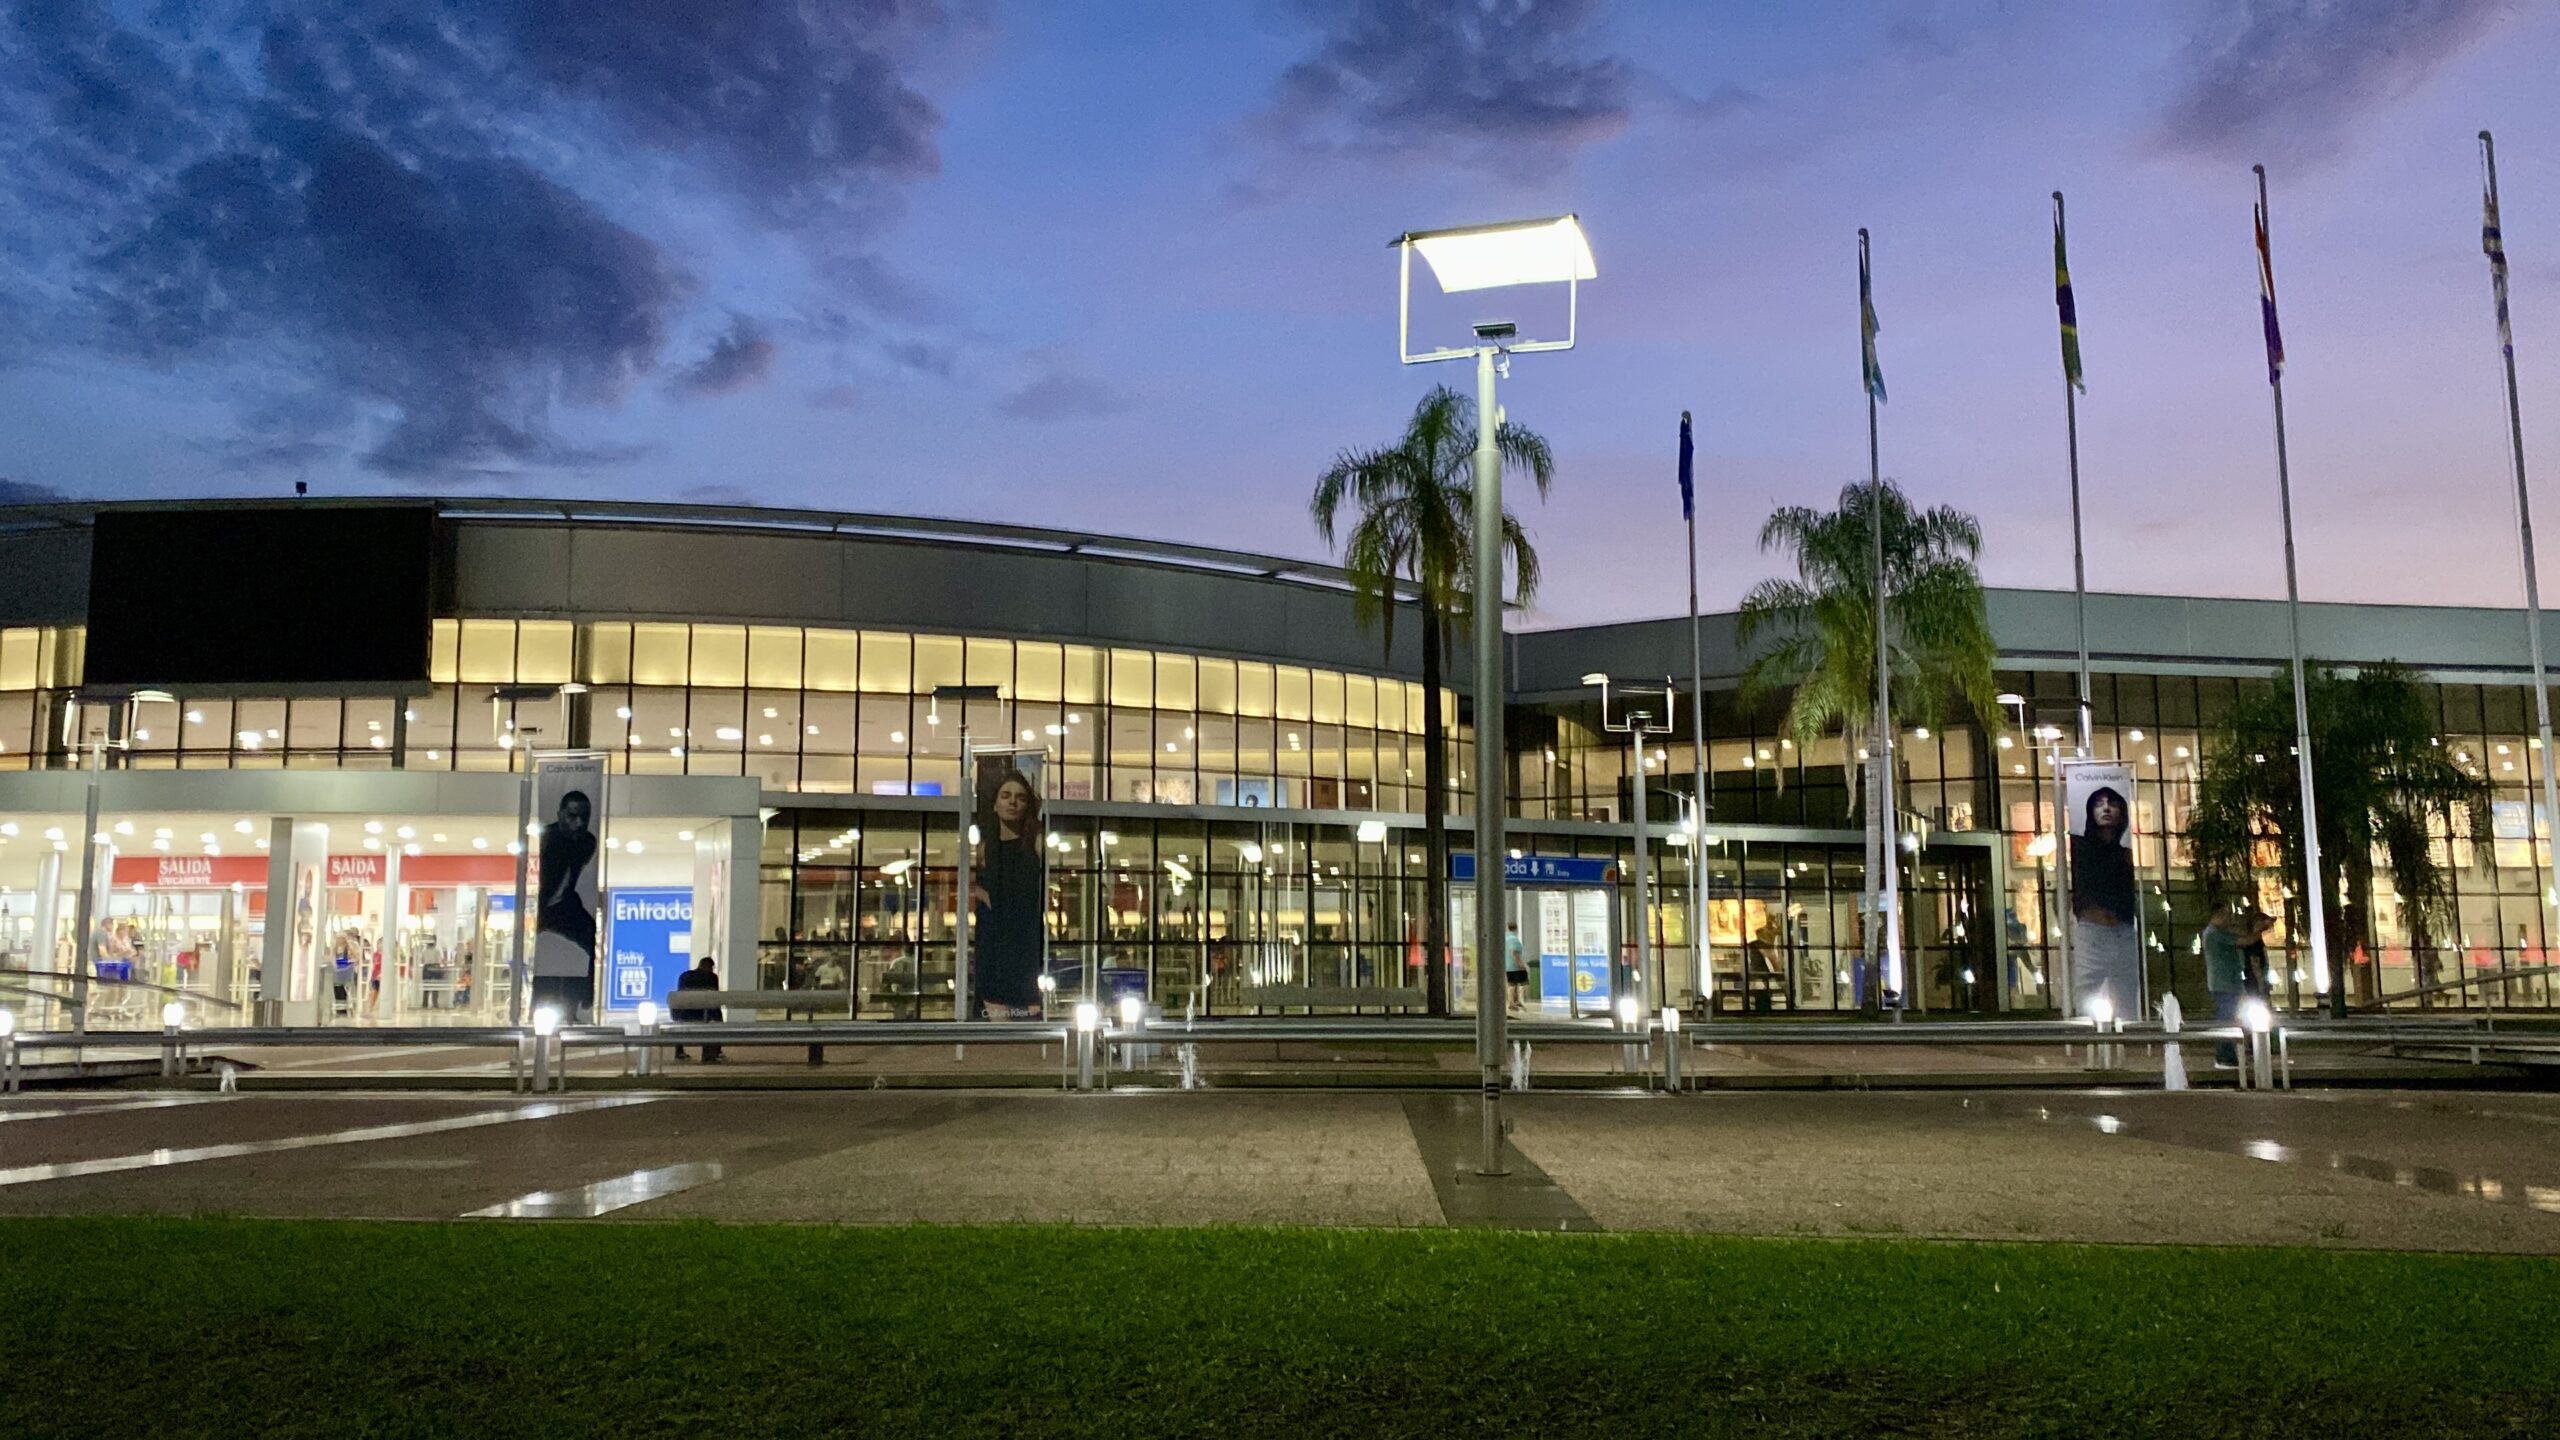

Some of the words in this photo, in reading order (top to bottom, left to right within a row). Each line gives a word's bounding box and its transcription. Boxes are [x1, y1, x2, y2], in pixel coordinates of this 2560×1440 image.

[546, 763, 574, 773] Calvin
[576, 763, 596, 772] Klein
[2075, 773, 2102, 781] Calvin
[2104, 773, 2123, 781] Klein
[159, 858, 212, 875] SALIDA
[616, 899, 692, 921] Entrada
[616, 951, 645, 967] Entry
